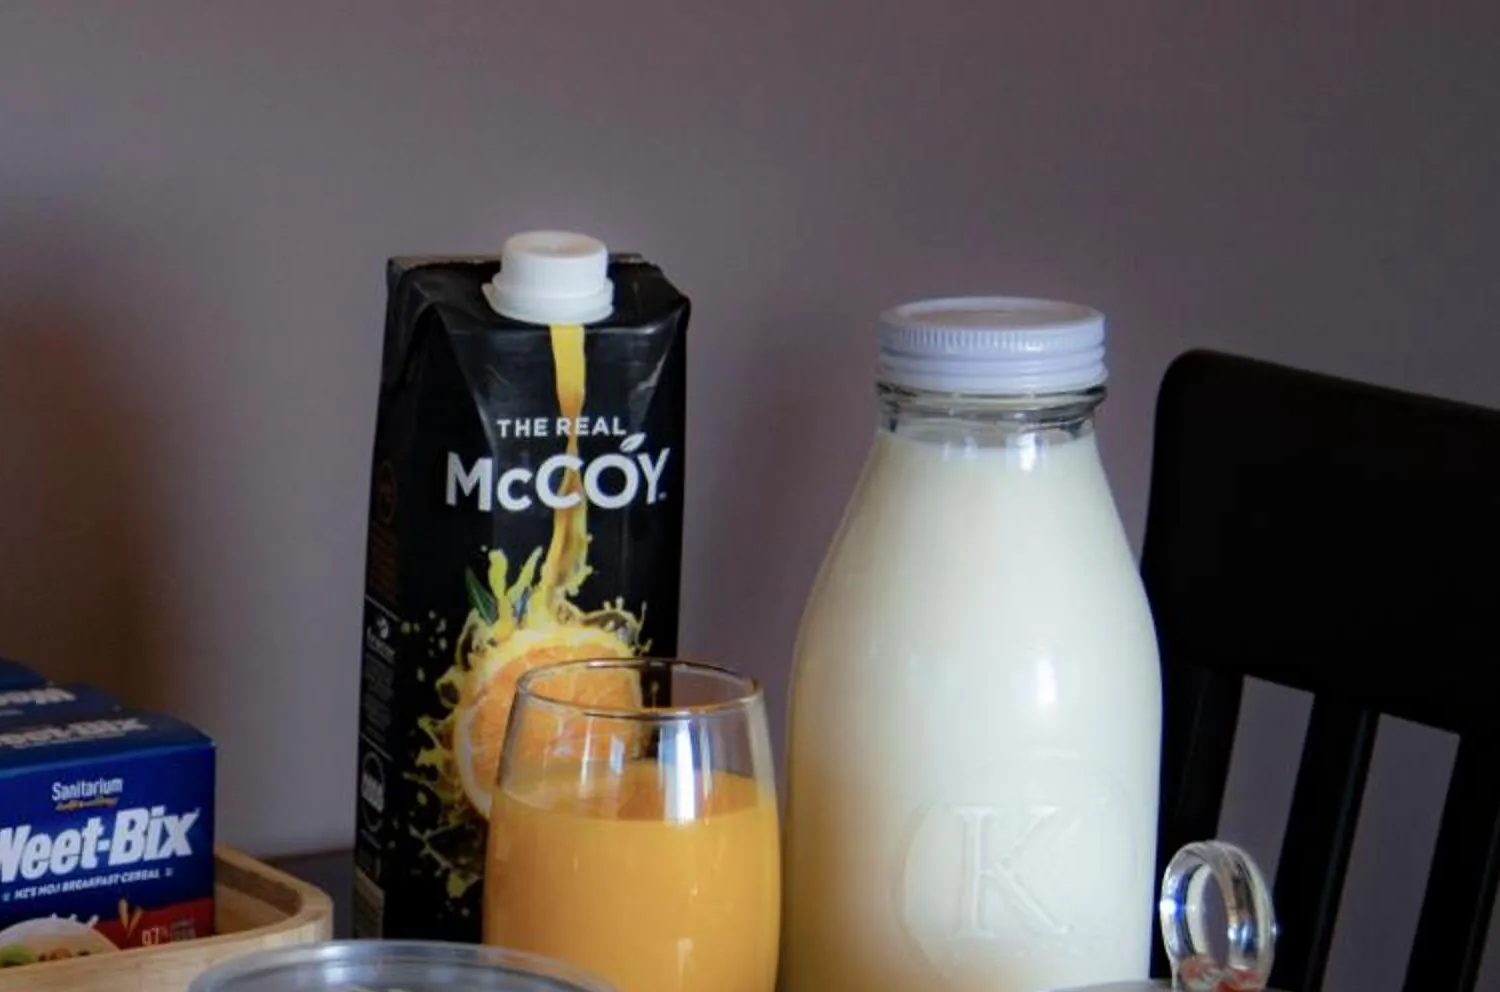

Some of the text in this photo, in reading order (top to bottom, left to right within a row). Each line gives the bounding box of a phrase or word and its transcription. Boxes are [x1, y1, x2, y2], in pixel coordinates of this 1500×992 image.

[496, 416, 627, 438] THE REAL
[51, 776, 124, 802] Sanitarium
